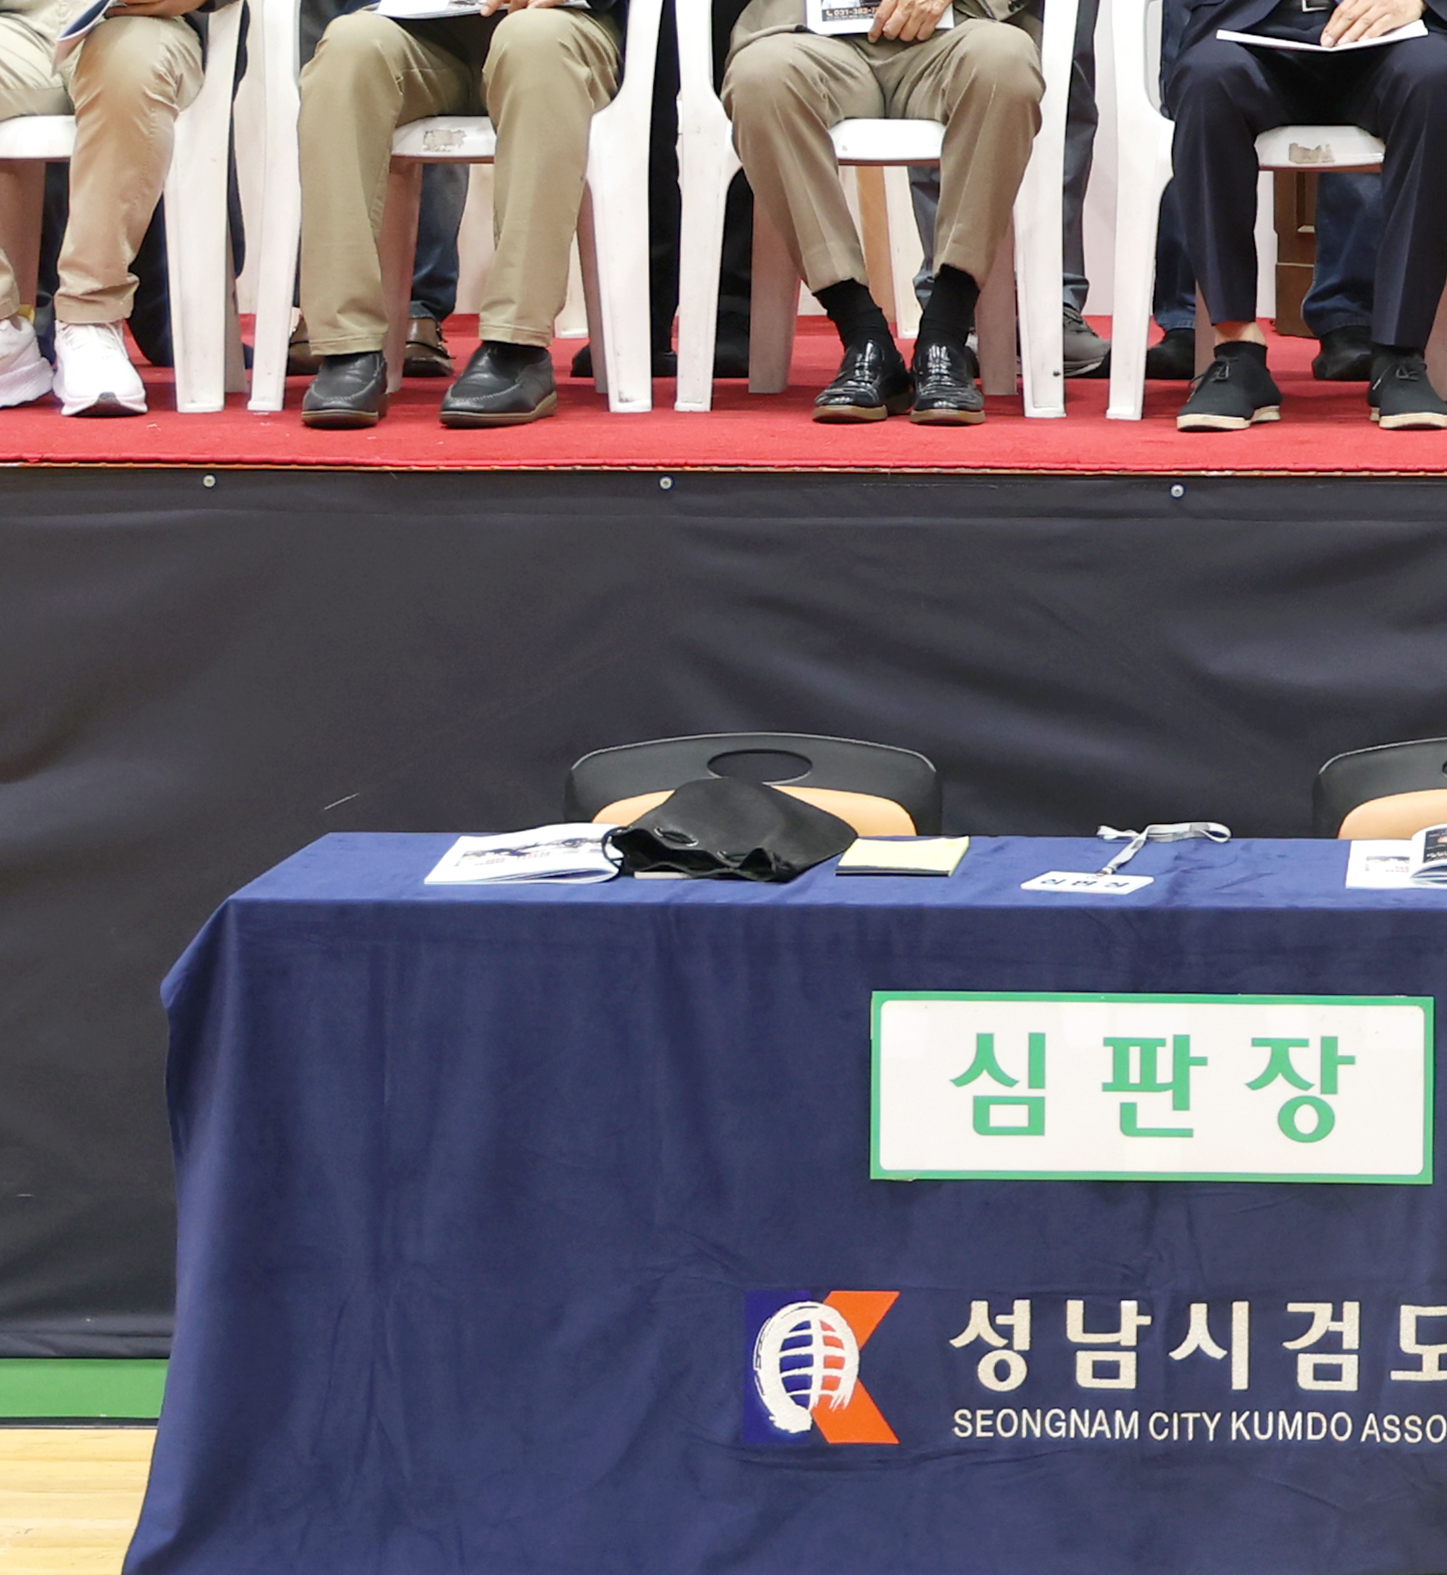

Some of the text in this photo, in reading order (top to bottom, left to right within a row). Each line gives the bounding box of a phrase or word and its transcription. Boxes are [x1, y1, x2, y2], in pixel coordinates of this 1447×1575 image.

[949, 1031, 1356, 1144] 심판장
[952, 1407, 1141, 1440] SEONGNAM
[1148, 1407, 1220, 1440] CITY
[1230, 1408, 1354, 1441] KUMDO
